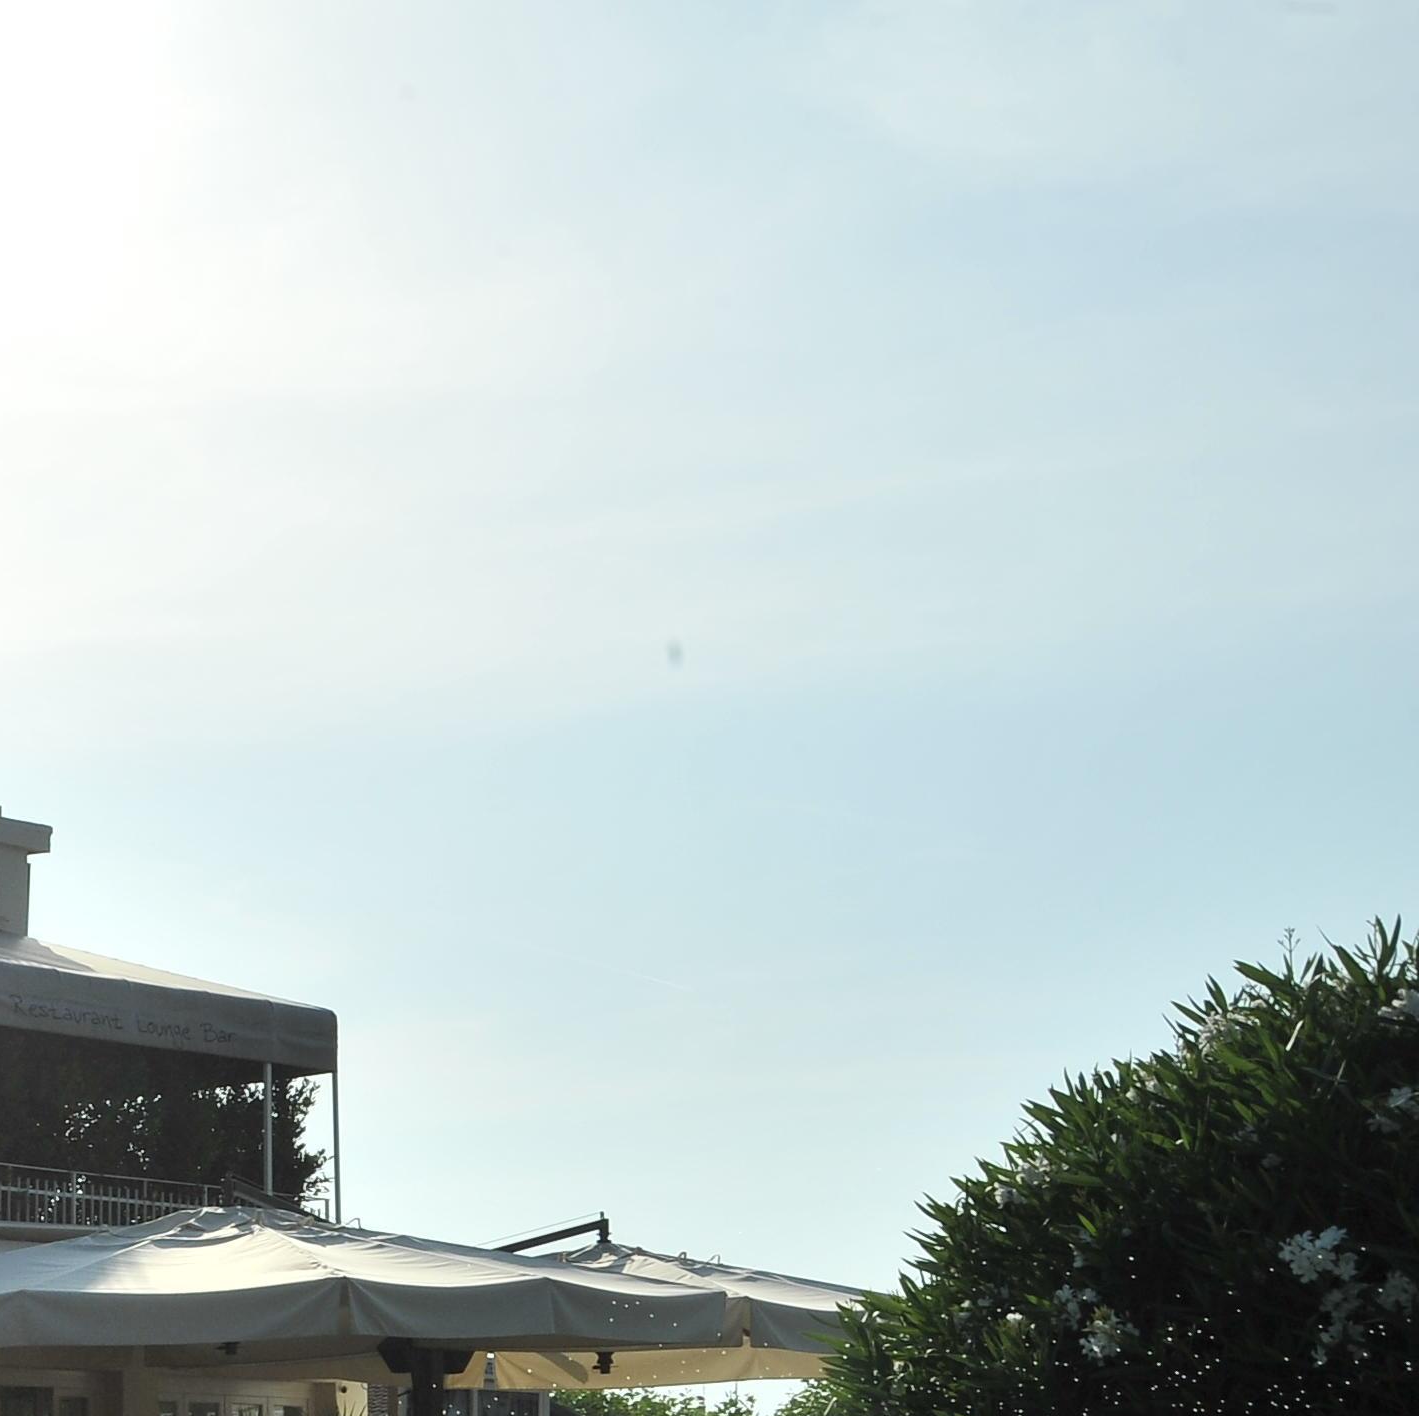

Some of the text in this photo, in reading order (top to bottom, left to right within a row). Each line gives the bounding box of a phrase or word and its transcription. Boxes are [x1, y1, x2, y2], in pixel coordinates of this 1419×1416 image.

[11, 995, 239, 1049] Restaurant Lounge Bar
